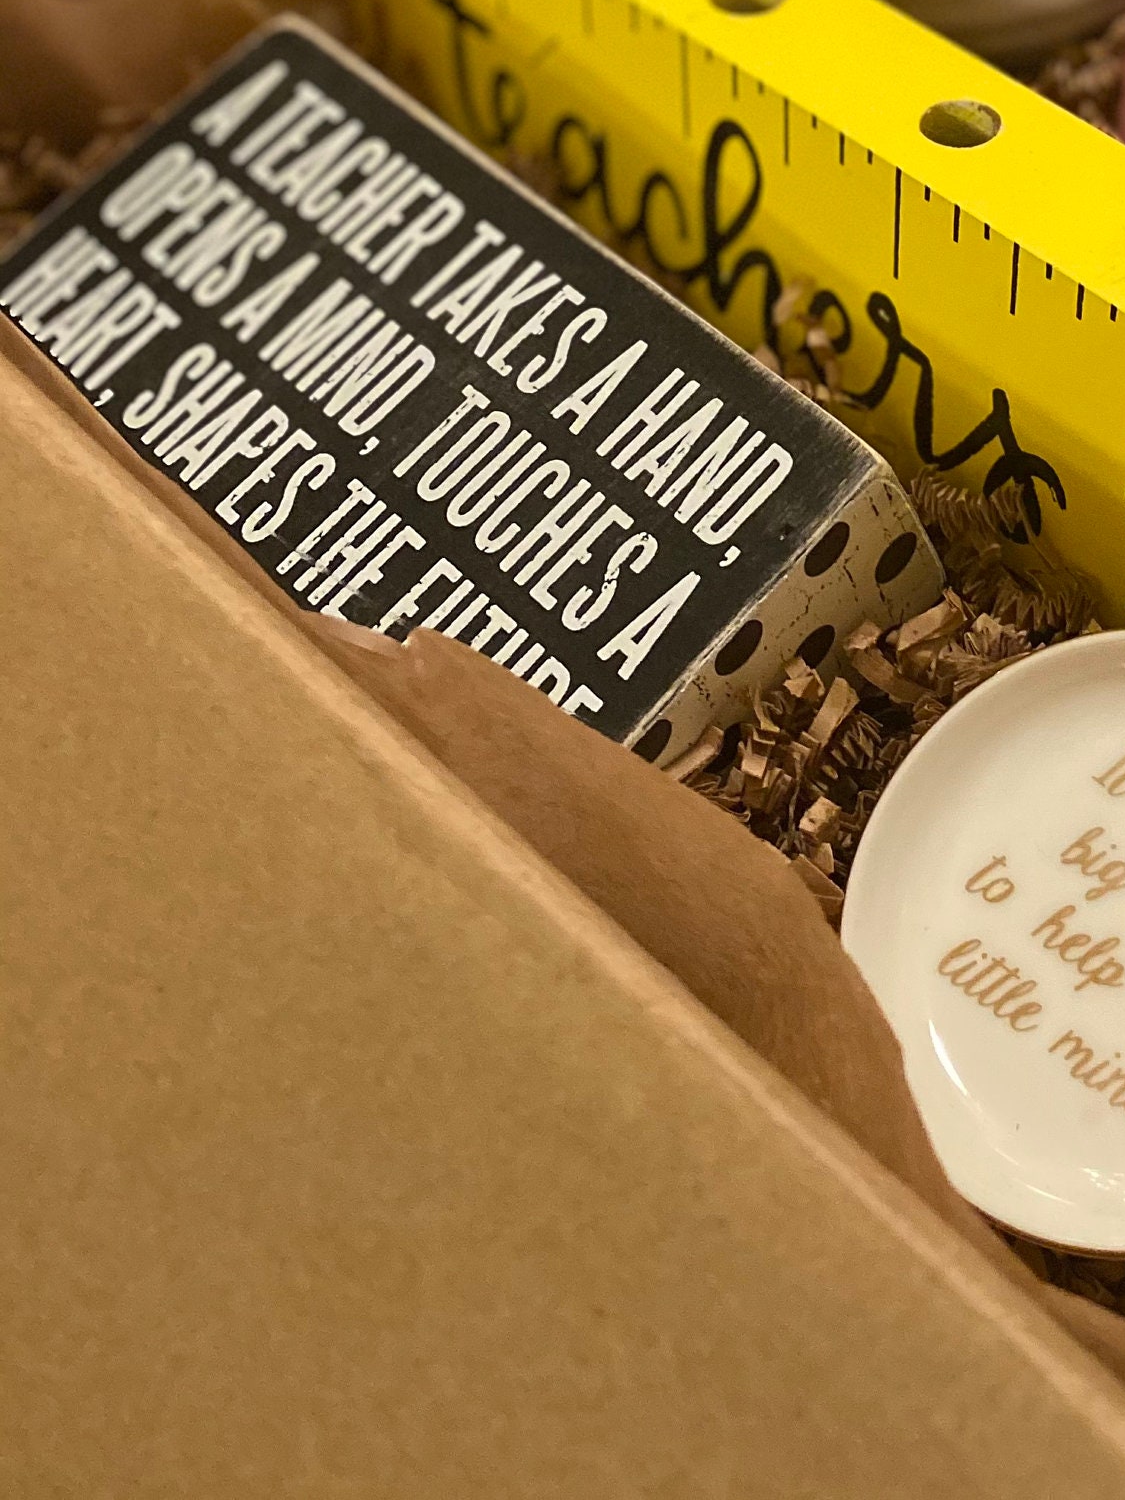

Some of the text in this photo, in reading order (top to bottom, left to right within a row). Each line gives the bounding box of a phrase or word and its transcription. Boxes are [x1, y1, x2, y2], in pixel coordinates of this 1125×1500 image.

[0, 226, 182, 407] HEART,
[122, 342, 335, 542] SHAPES
[276, 478, 427, 622] THE
[100, 143, 703, 682] OPENS A MIND, TOUCHES A
[189, 59, 795, 568] A TEACHER TAKES A HAND,
[938, 938, 1043, 1032] little
[964, 854, 1015, 904] to
[1031, 904, 1125, 992] help
